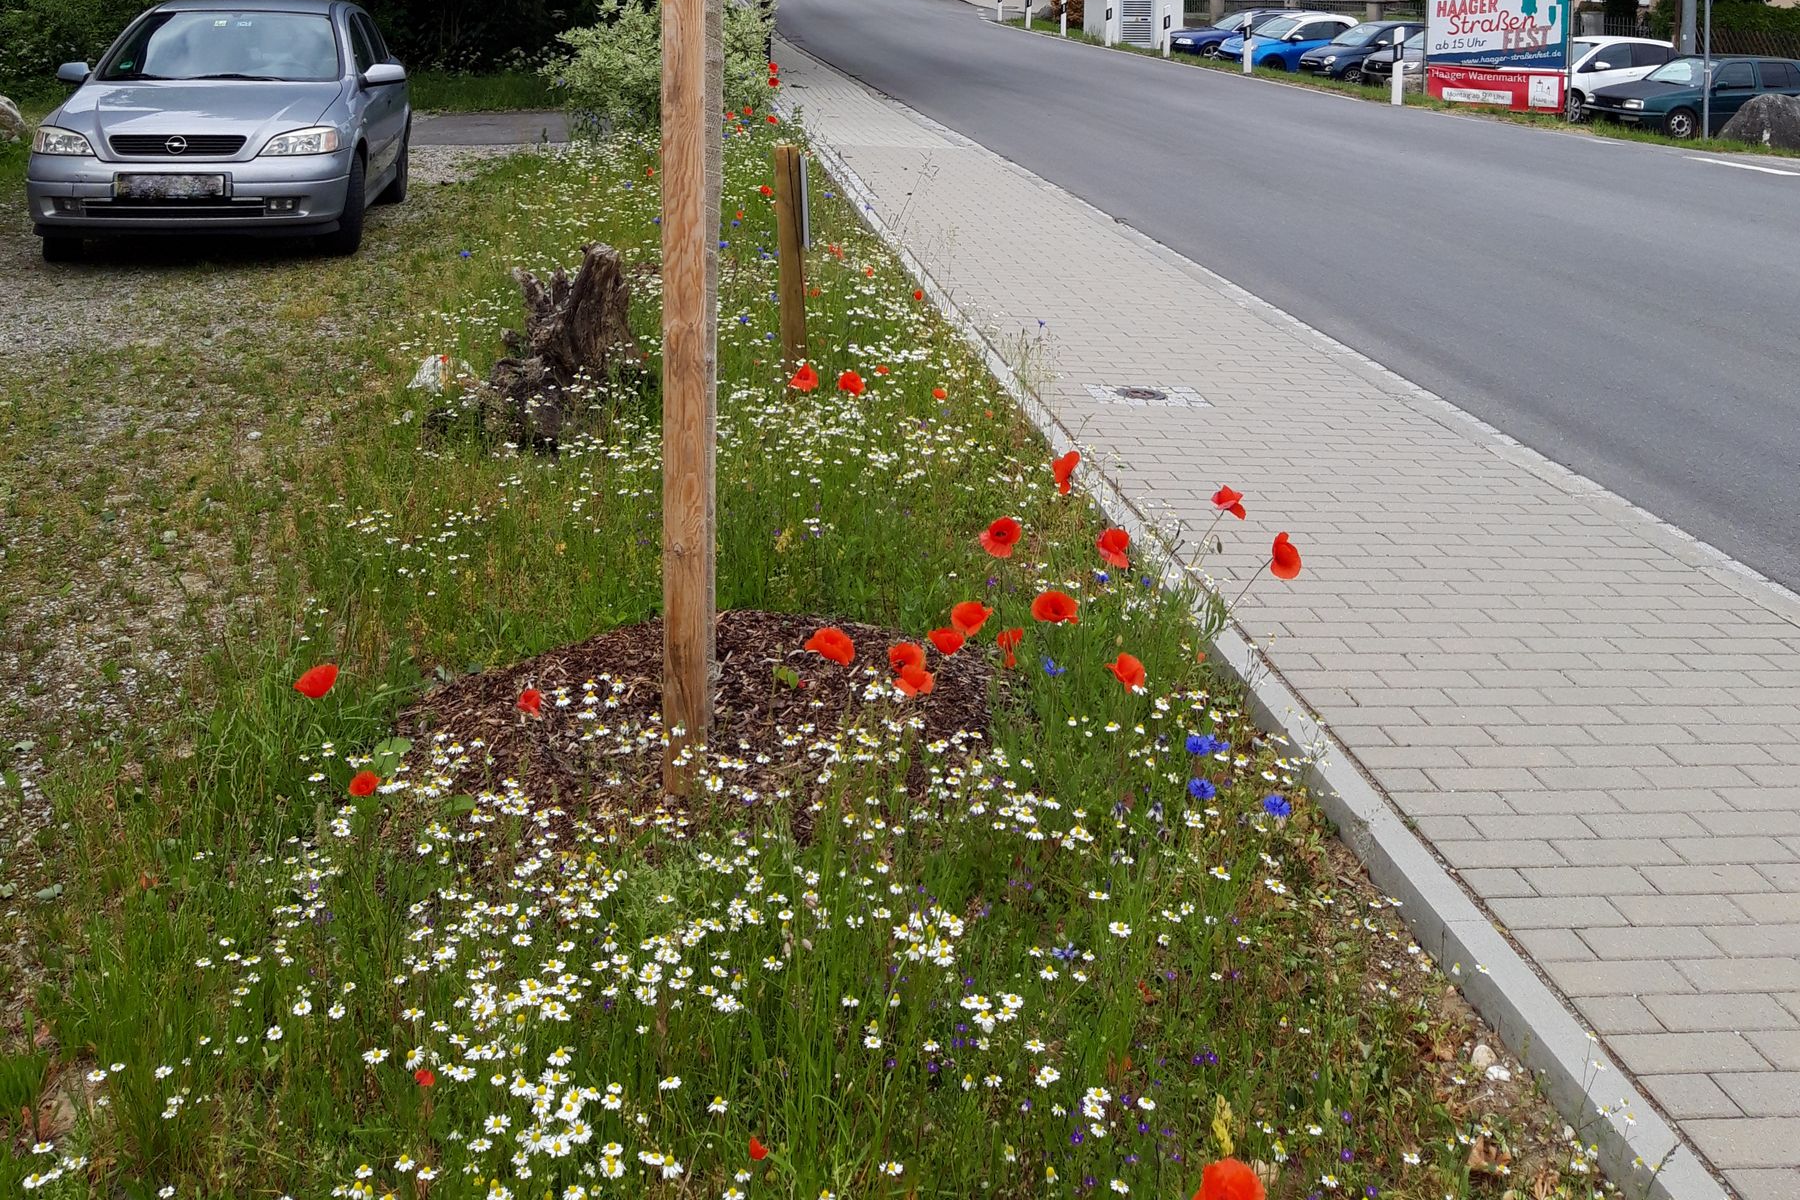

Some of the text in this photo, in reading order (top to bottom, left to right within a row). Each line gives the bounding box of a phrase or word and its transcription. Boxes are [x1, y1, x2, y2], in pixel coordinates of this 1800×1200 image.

[1447, 10, 1538, 36] Straßen
[1435, 37, 1487, 51] ab 15 Uhr
[1502, 25, 1552, 52] FEST
[1431, 69, 1527, 83] Haager Warenmarkt
